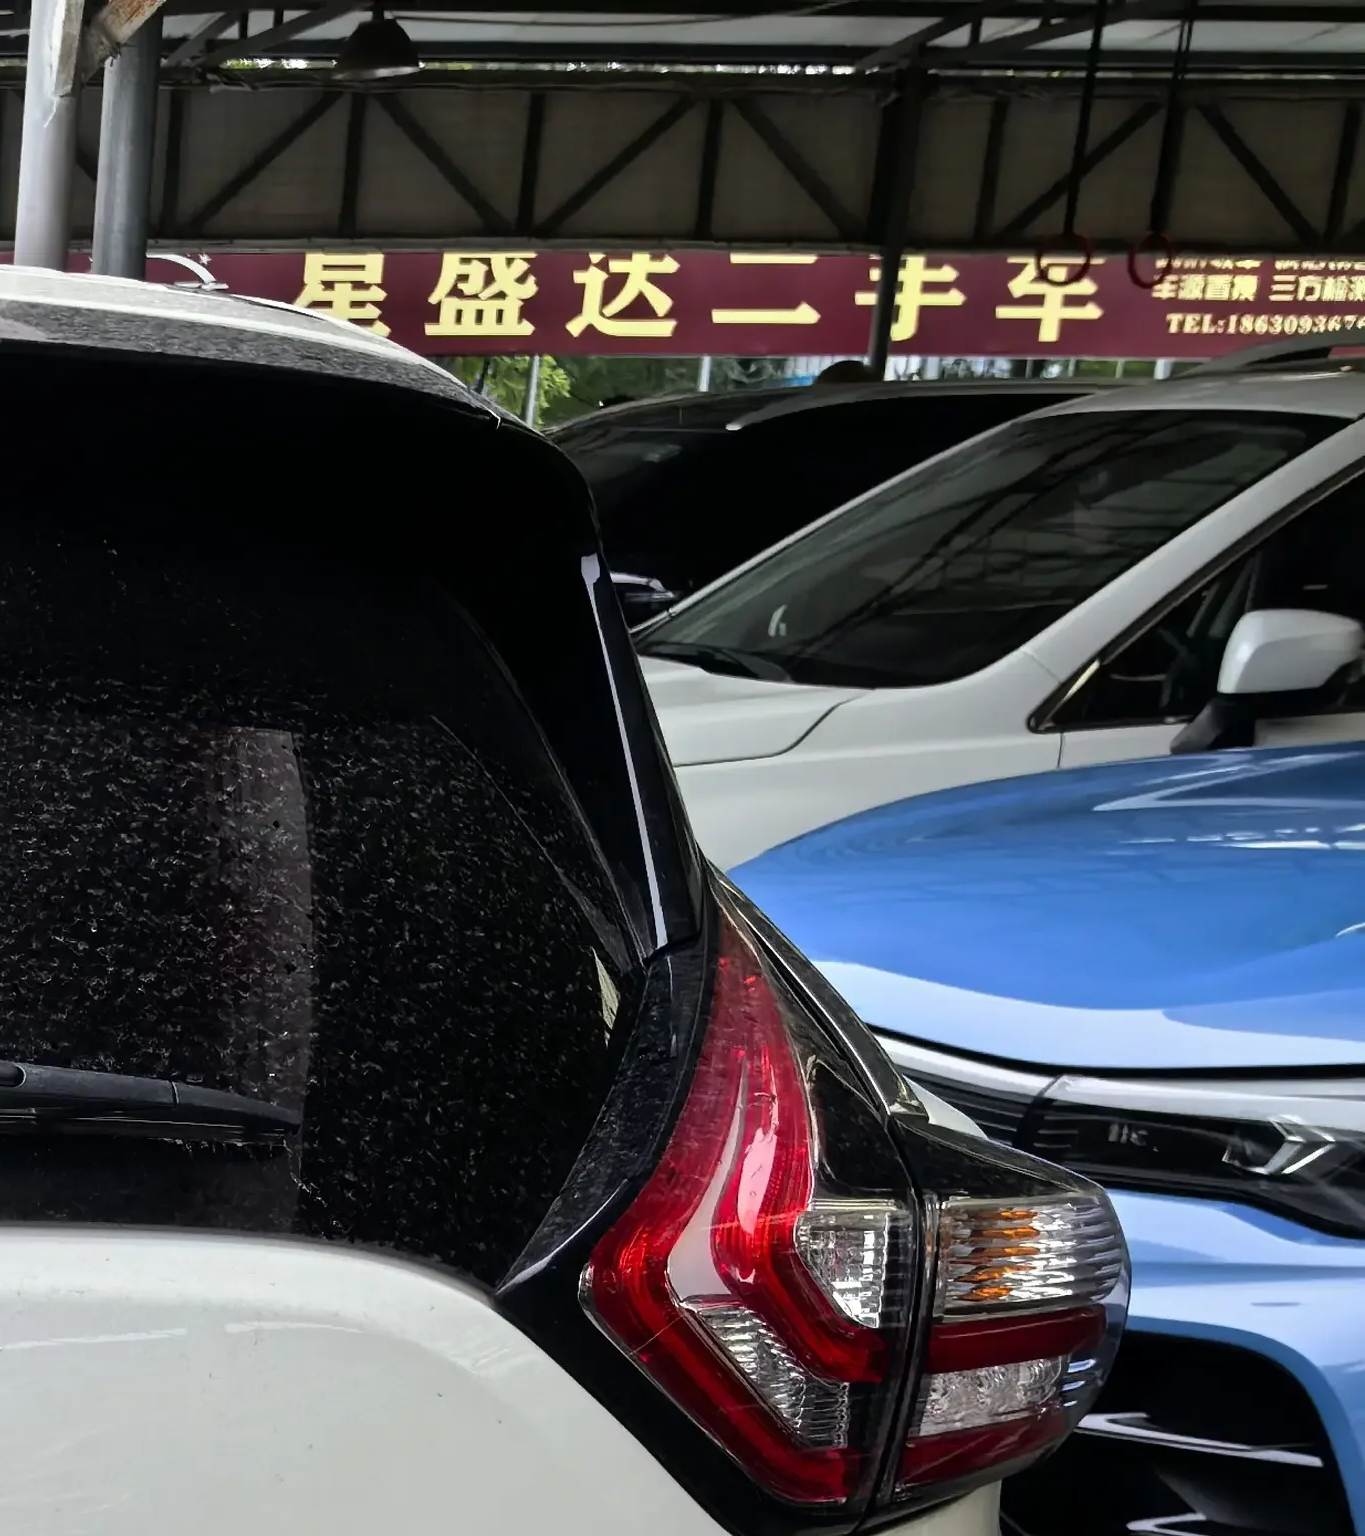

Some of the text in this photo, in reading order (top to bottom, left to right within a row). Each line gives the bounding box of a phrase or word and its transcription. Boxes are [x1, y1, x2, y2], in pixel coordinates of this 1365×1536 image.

[290, 251, 1107, 342] 星盛达二手车
